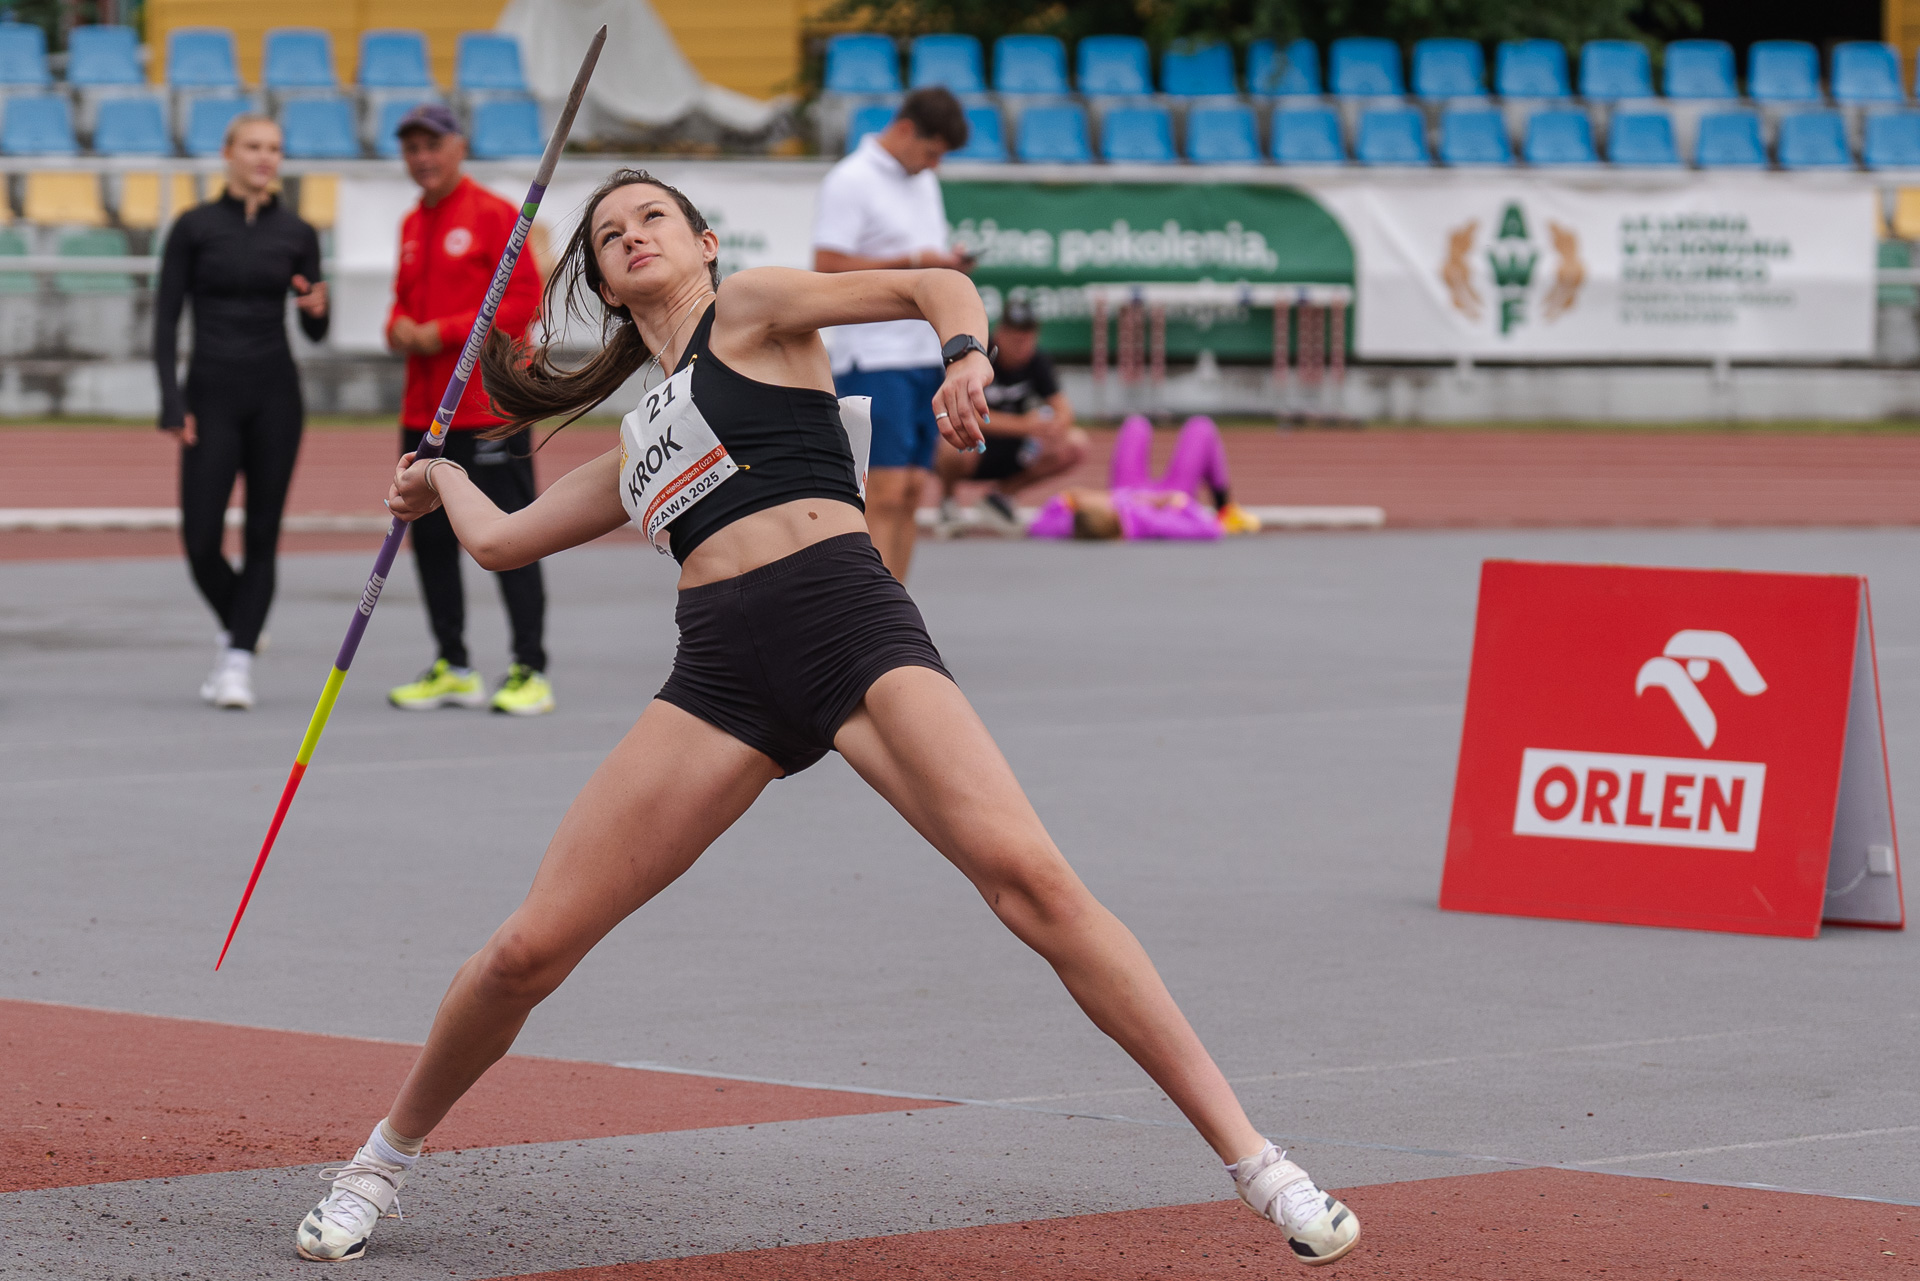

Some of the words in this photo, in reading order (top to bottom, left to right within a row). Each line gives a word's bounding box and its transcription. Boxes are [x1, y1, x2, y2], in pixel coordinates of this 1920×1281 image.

[945, 218, 1054, 268] óżne
[1058, 219, 1278, 273] pokolenia,
[455, 316, 490, 382] Nemeth
[507, 216, 531, 255] 75m
[646, 381, 675, 424] 21
[628, 424, 684, 507] KROK
[665, 467, 700, 495] wielobojach
[698, 458, 712, 470] (U23
[649, 495, 691, 541] RSZAWA
[689, 471, 719, 498] 2025
[359, 572, 386, 616] 600g
[1533, 764, 1747, 835] ORLEN
